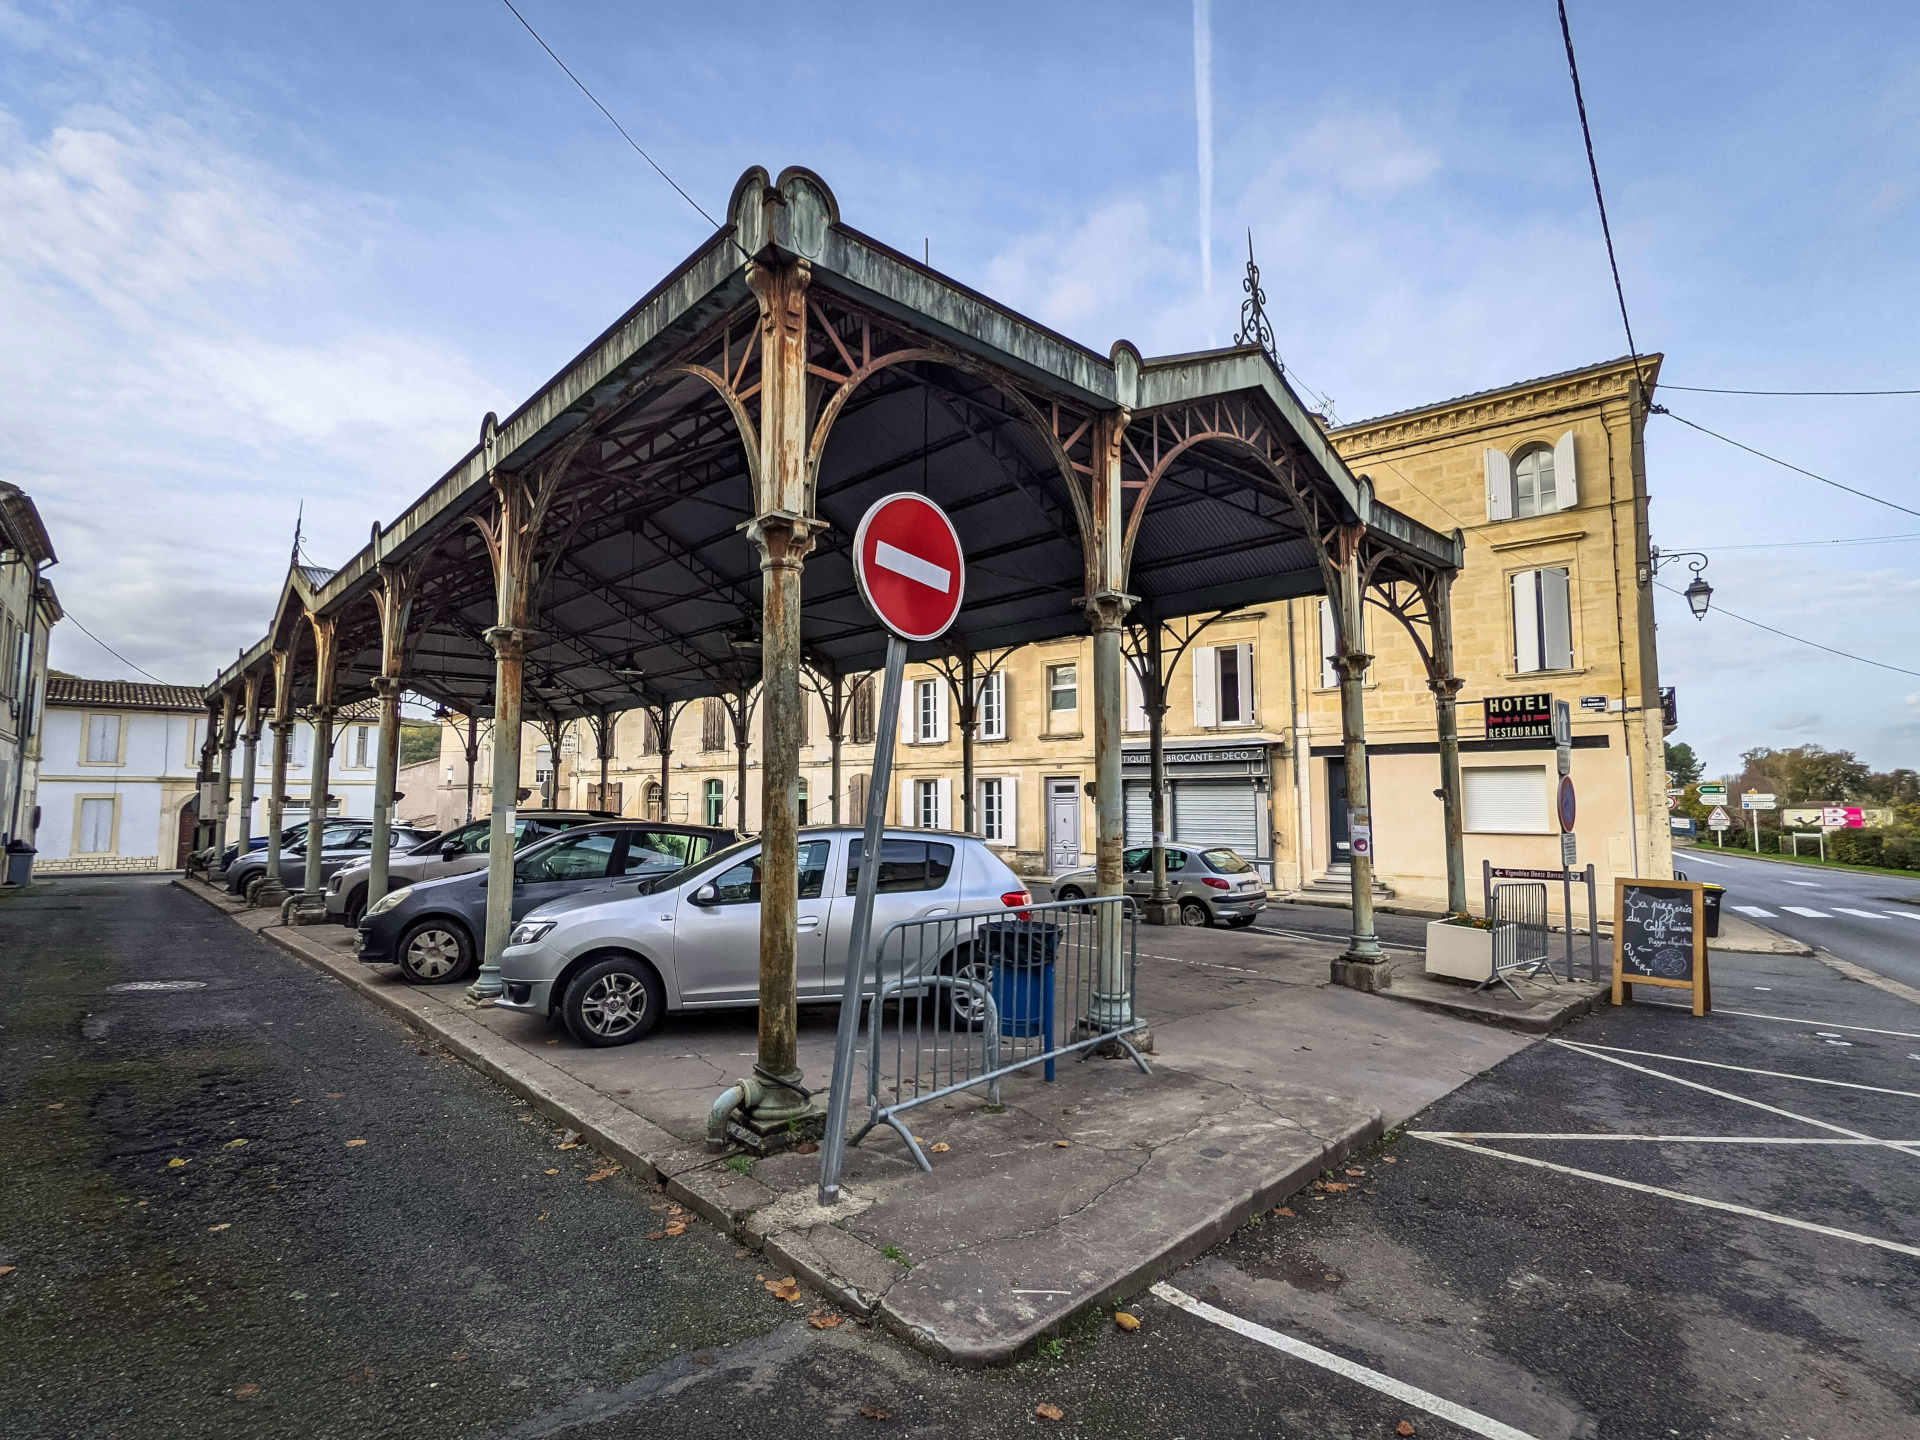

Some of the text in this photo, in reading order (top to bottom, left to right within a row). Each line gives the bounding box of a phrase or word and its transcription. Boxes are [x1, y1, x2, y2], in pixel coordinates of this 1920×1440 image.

[1489, 696, 1548, 713] HOTEL
[1488, 725, 1550, 738] RESTAURANT
[1122, 754, 1151, 763] TIQUIT
[1166, 752, 1213, 763] BROCANTE
[1624, 887, 1693, 921] La pizzeria
[1625, 908, 1642, 922] du
[1624, 942, 1653, 976] OUVERT
